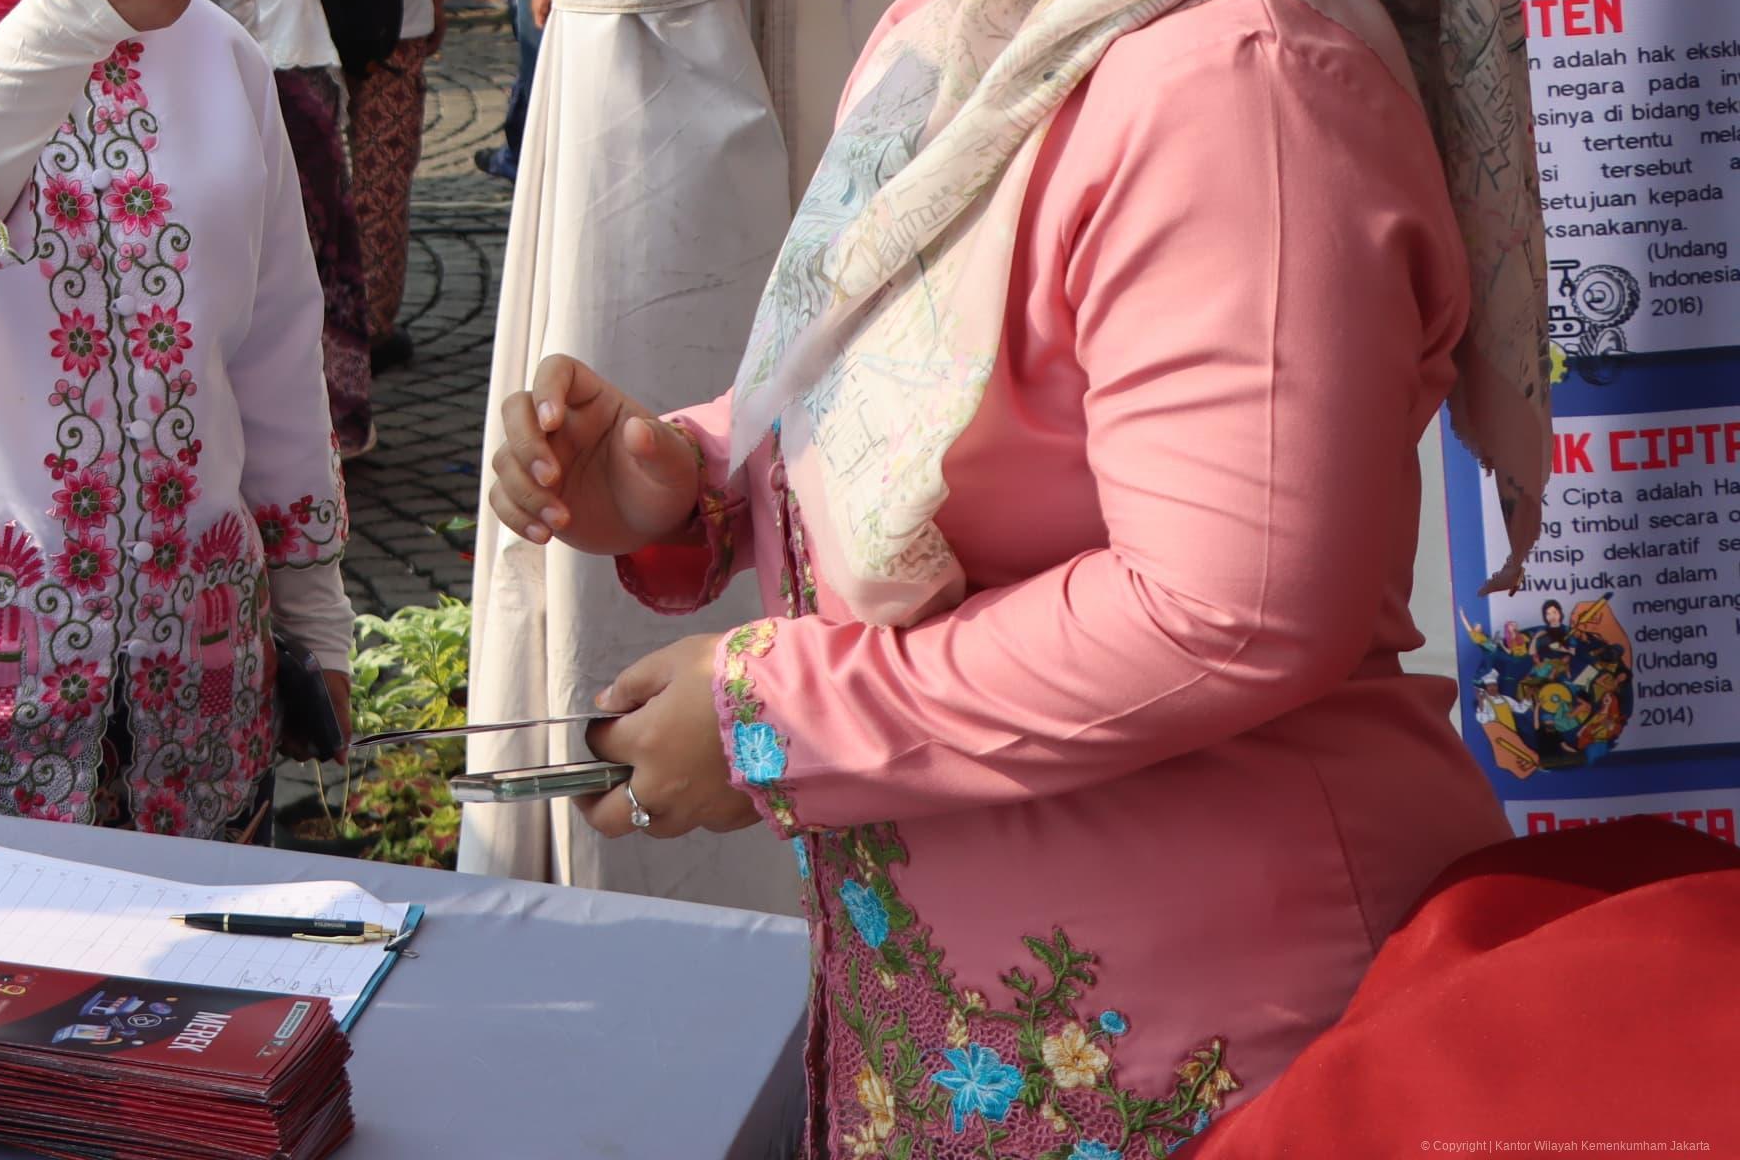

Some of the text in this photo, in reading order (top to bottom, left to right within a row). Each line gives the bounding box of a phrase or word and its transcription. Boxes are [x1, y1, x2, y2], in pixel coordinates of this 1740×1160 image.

[1553, 49, 1627, 70] adalah
[1638, 45, 1675, 64] hak
[1547, 80, 1625, 100] negara
[1648, 73, 1700, 96] pada
[1533, 97, 1740, 129] sinya di bidang tek
[1583, 131, 1674, 153] tertentu
[1600, 157, 1694, 180] tersebut
[1540, 184, 1724, 213] setujuan kepada
[1545, 217, 1689, 239] ksanakannya.
[1647, 240, 1728, 264] (Undang
[1648, 265, 1740, 288] Indonesia
[1563, 486, 1623, 509] Cipta
[1635, 481, 1702, 502] adalah
[1572, 513, 1639, 534] timbul
[1648, 510, 1719, 530] secara
[1525, 545, 1584, 567] rinsip
[1603, 537, 1701, 562] deklaratif
[1656, 566, 1718, 586] dalam
[1635, 623, 1708, 645] dengan
[1636, 649, 1718, 673] (Undang
[1637, 675, 1733, 700] Indonesia
[1640, 706, 1695, 728] 2014)
[167, 1010, 233, 1054] MEREK
